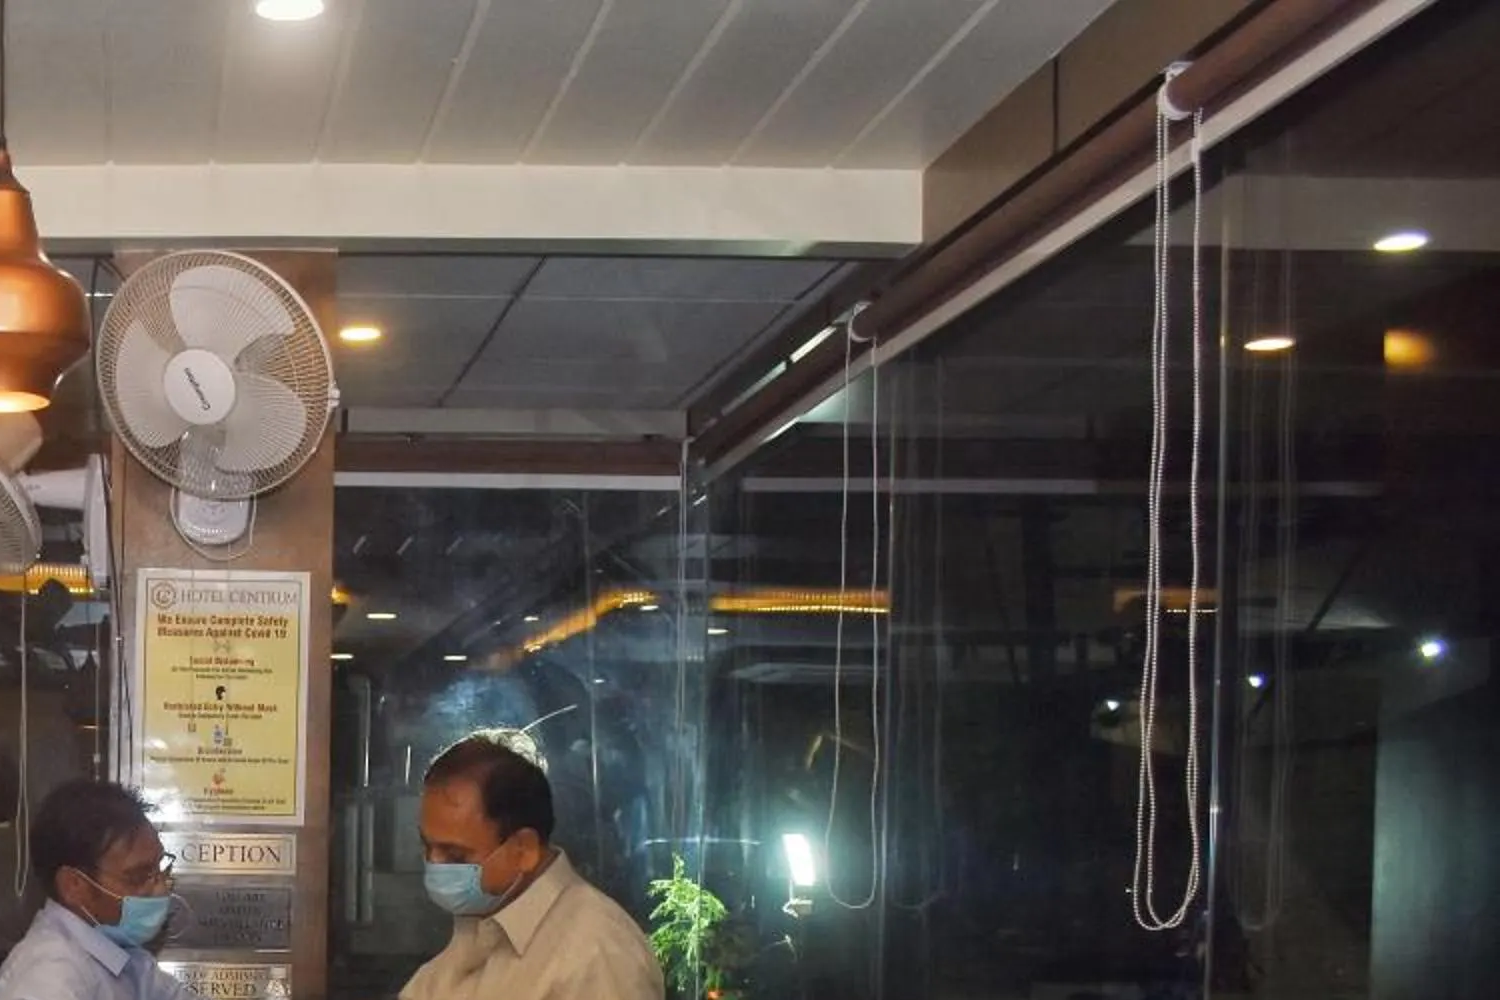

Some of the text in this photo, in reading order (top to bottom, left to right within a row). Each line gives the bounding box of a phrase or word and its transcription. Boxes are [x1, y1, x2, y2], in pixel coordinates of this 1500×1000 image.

[181, 589, 297, 605] HOTEL CENTRUM
[257, 615, 289, 628] Safety
[182, 842, 281, 863] CEPTION
[186, 982, 257, 997] SERVED
